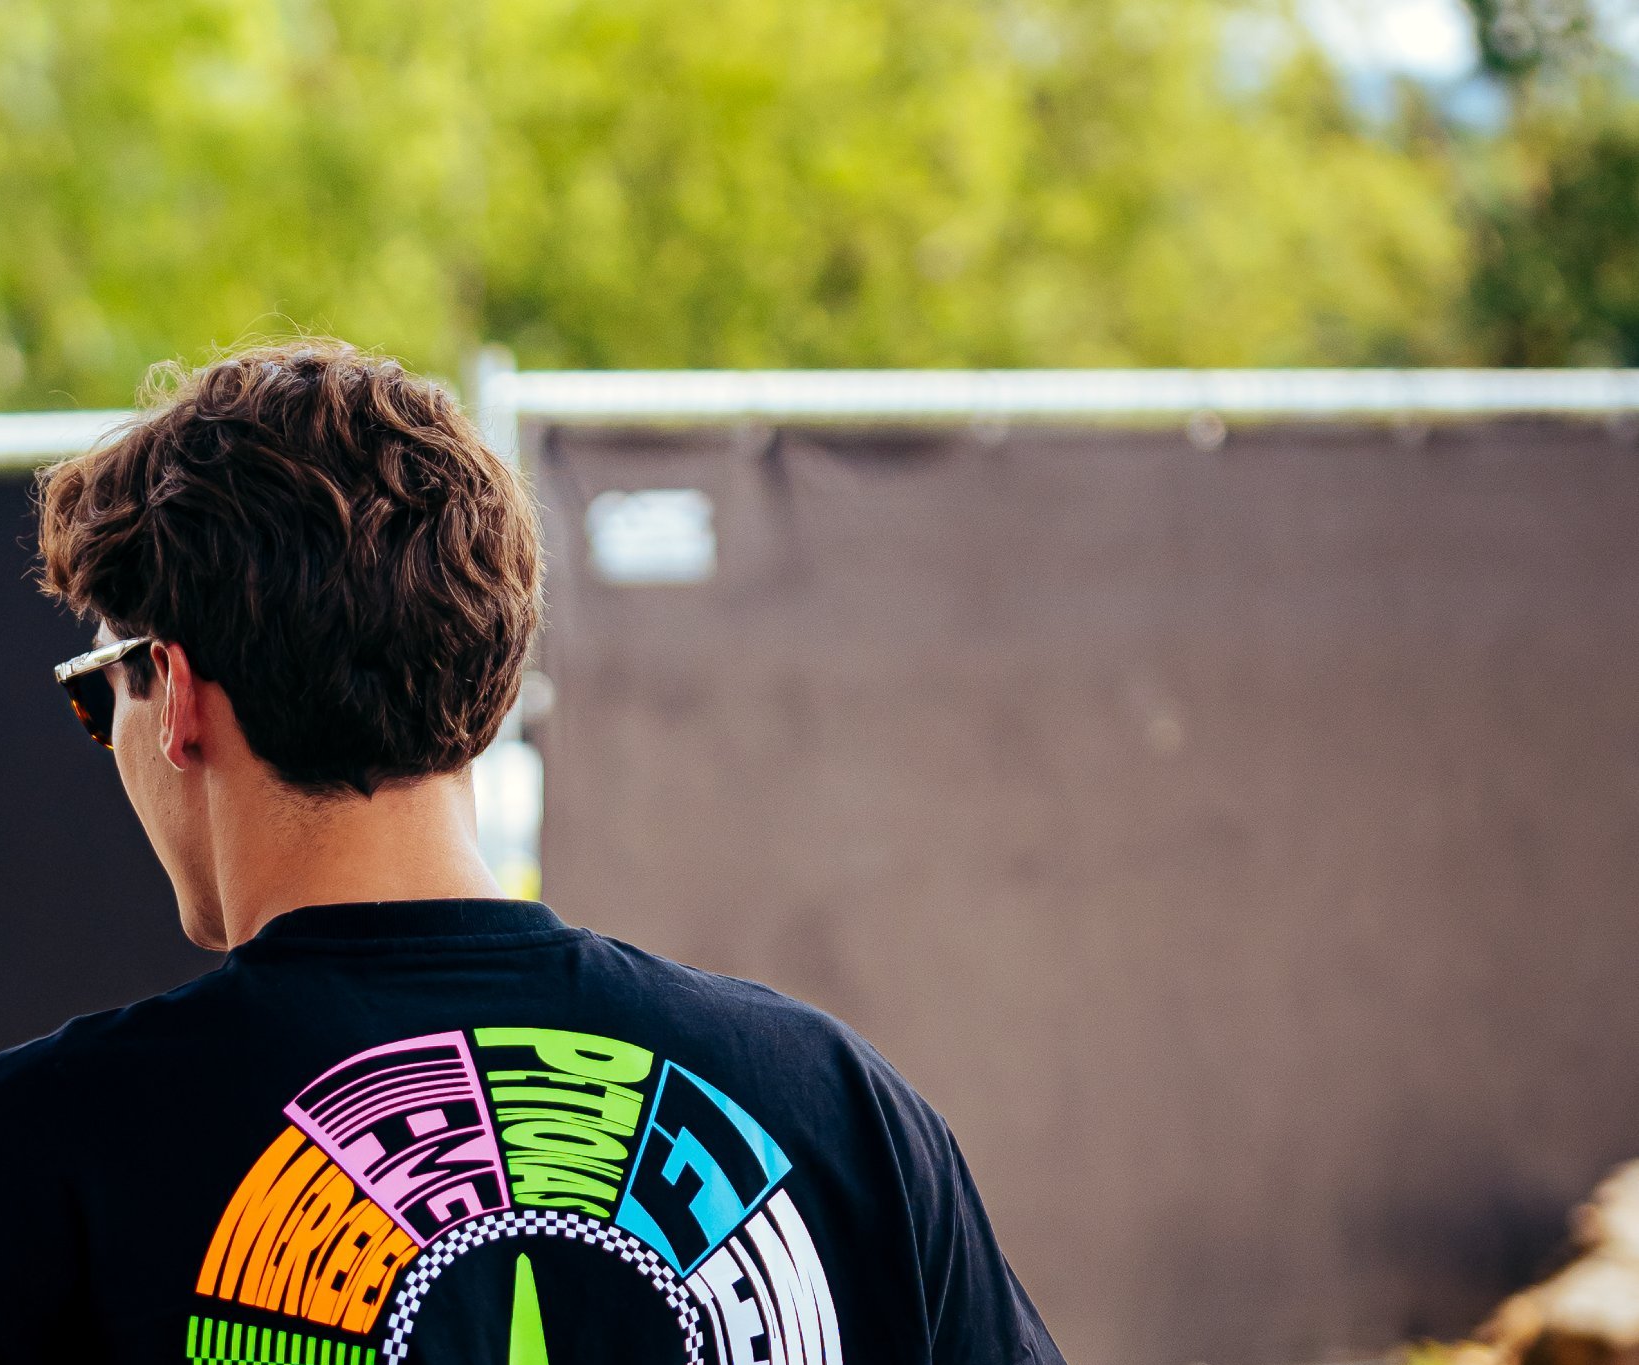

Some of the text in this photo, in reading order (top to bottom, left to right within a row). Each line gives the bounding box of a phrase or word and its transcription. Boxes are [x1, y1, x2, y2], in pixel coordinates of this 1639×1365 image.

[195, 1124, 419, 1334] MERCEDES
[473, 1027, 654, 1218] PETRONAS
[624, 1062, 780, 1277] F1
